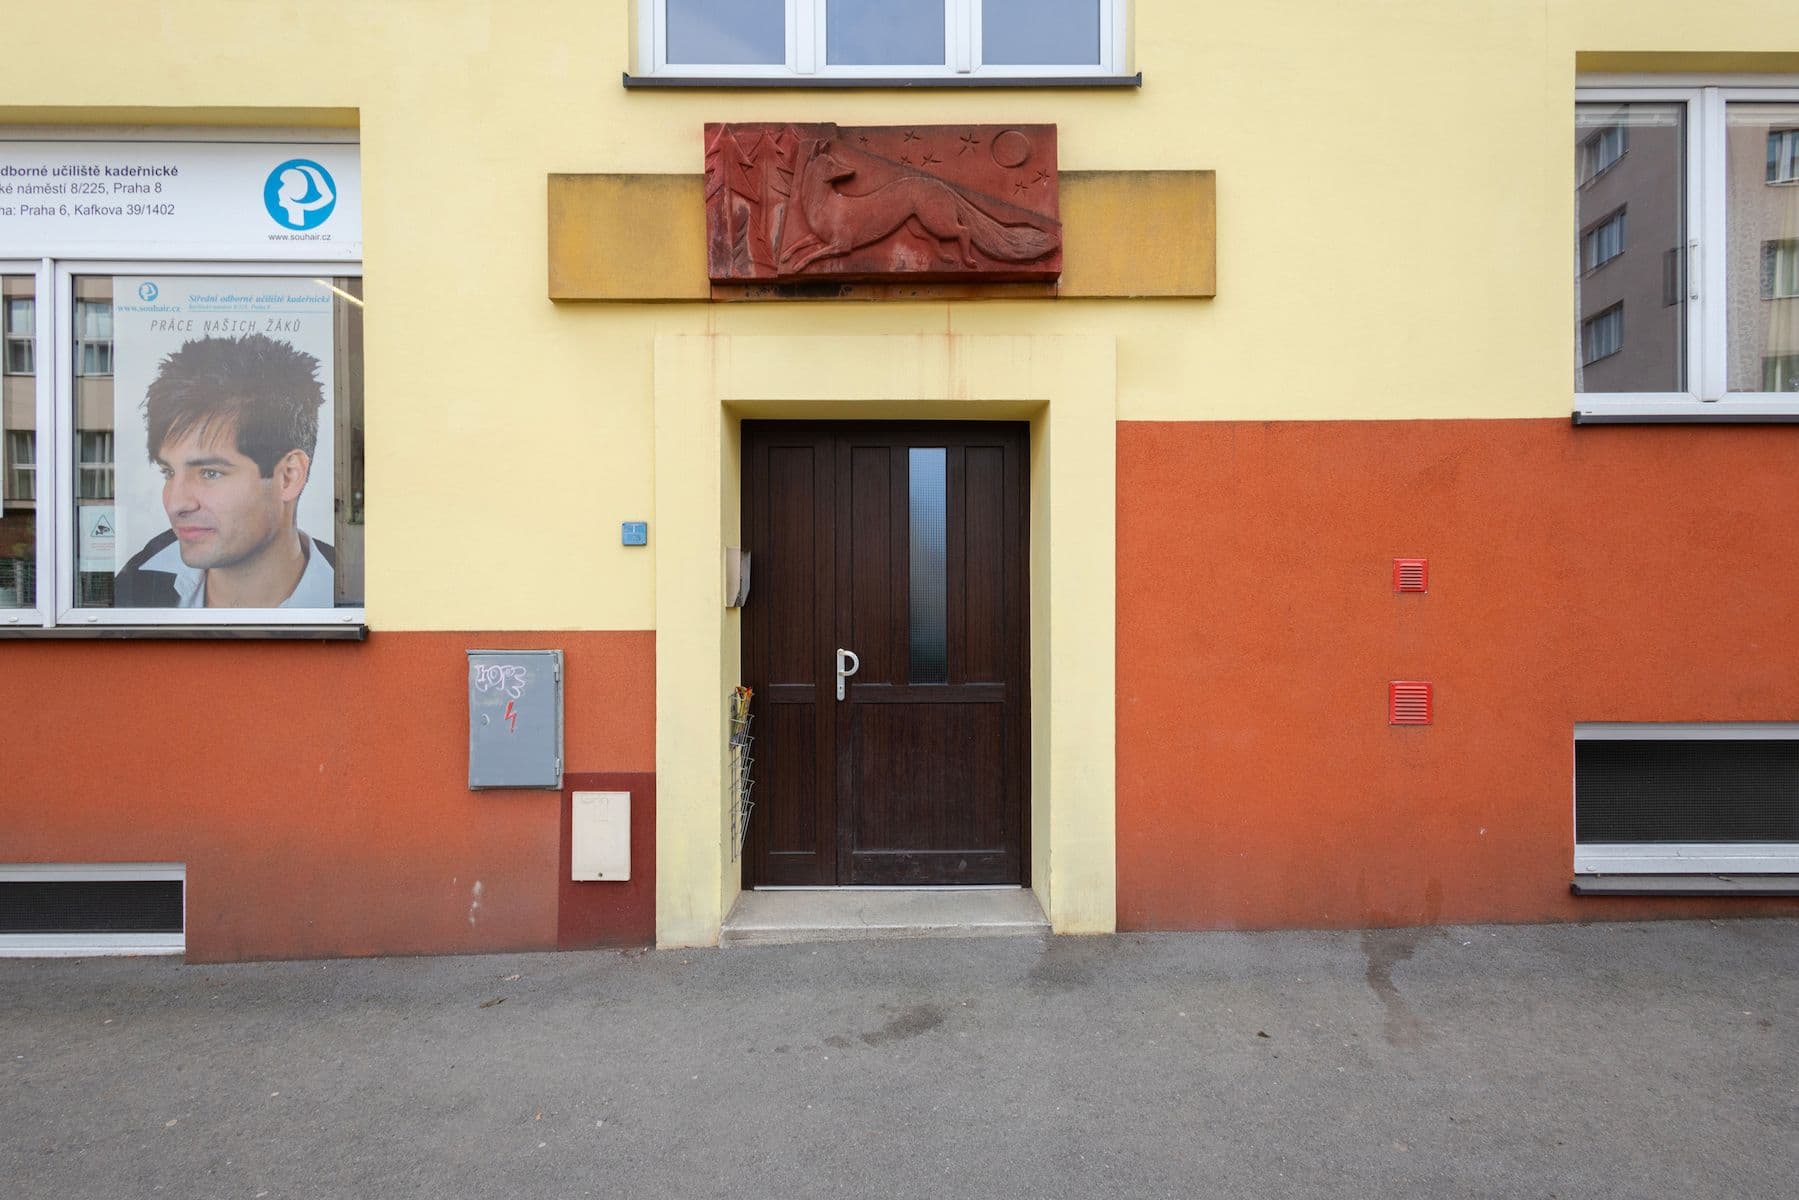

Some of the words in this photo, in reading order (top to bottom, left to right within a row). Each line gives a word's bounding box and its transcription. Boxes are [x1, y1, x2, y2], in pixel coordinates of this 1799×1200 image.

[52, 165, 100, 177] učiliště
[104, 164, 178, 177] kadeřnické
[17, 182, 66, 194] náměstí
[70, 182, 109, 195] 8/225,
[113, 182, 150, 194] Praha
[154, 182, 162, 194] 8
[20, 204, 56, 216] Praha
[59, 204, 71, 217] 6,
[74, 203, 122, 216] Kafkova
[126, 203, 175, 216] 39/1402
[267, 233, 331, 241] www.souhair.cz
[116, 304, 181, 313] www.souhair.cz
[150, 317, 193, 332] PRÁCE
[203, 317, 257, 332] NAŠICH
